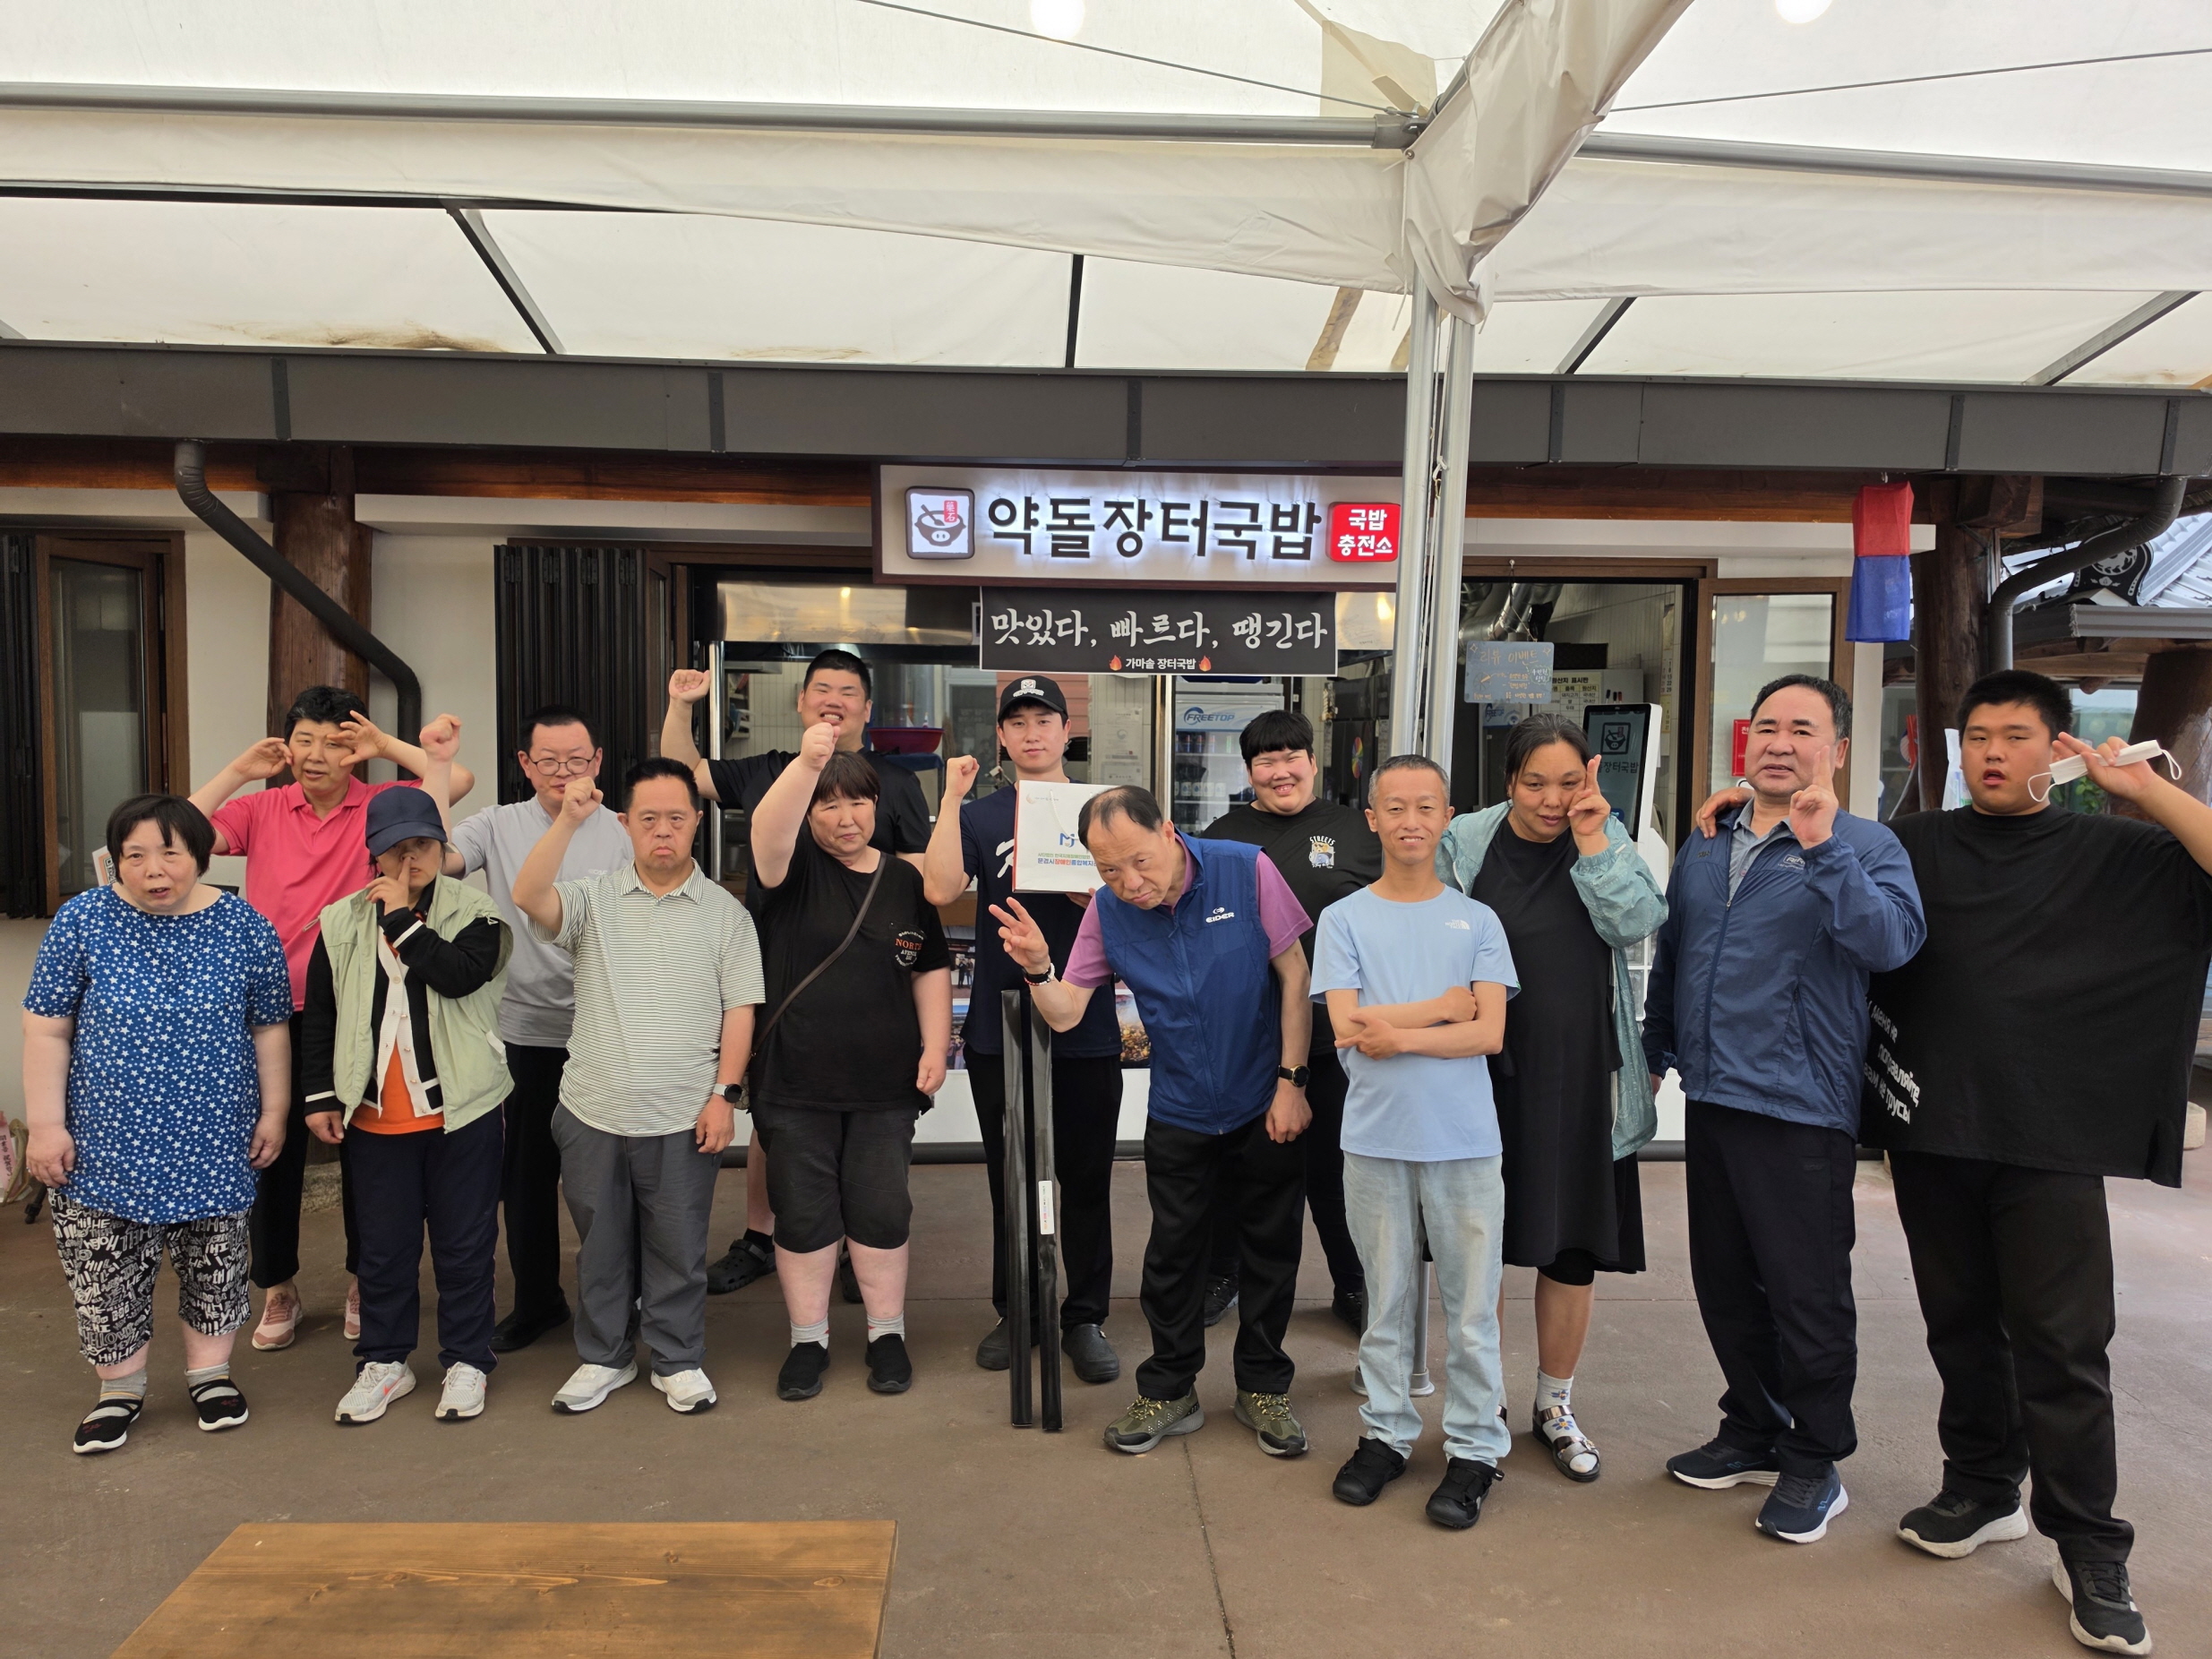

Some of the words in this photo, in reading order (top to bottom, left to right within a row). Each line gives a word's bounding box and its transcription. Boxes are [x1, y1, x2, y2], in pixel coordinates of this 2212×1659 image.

[988, 495, 1322, 561] 약돌장터국밥
[1349, 509, 1387, 530] 국밥
[1337, 534, 1393, 556] 충전소
[990, 607, 1097, 648] 맛있다,
[1110, 610, 1219, 649] 빠르다,
[1231, 612, 1328, 649] 땡긴다
[1125, 658, 1155, 670] 가마솥
[1157, 658, 1196, 670] 장터국밥
[1480, 647, 1501, 666] 리뷰
[1508, 649, 1539, 666] 이벤트
[1187, 714, 1235, 723] FREETOP
[1309, 836, 1335, 846] STREETS
[1205, 912, 1235, 923] EIDER
[1886, 1087, 1910, 1124] трусы
